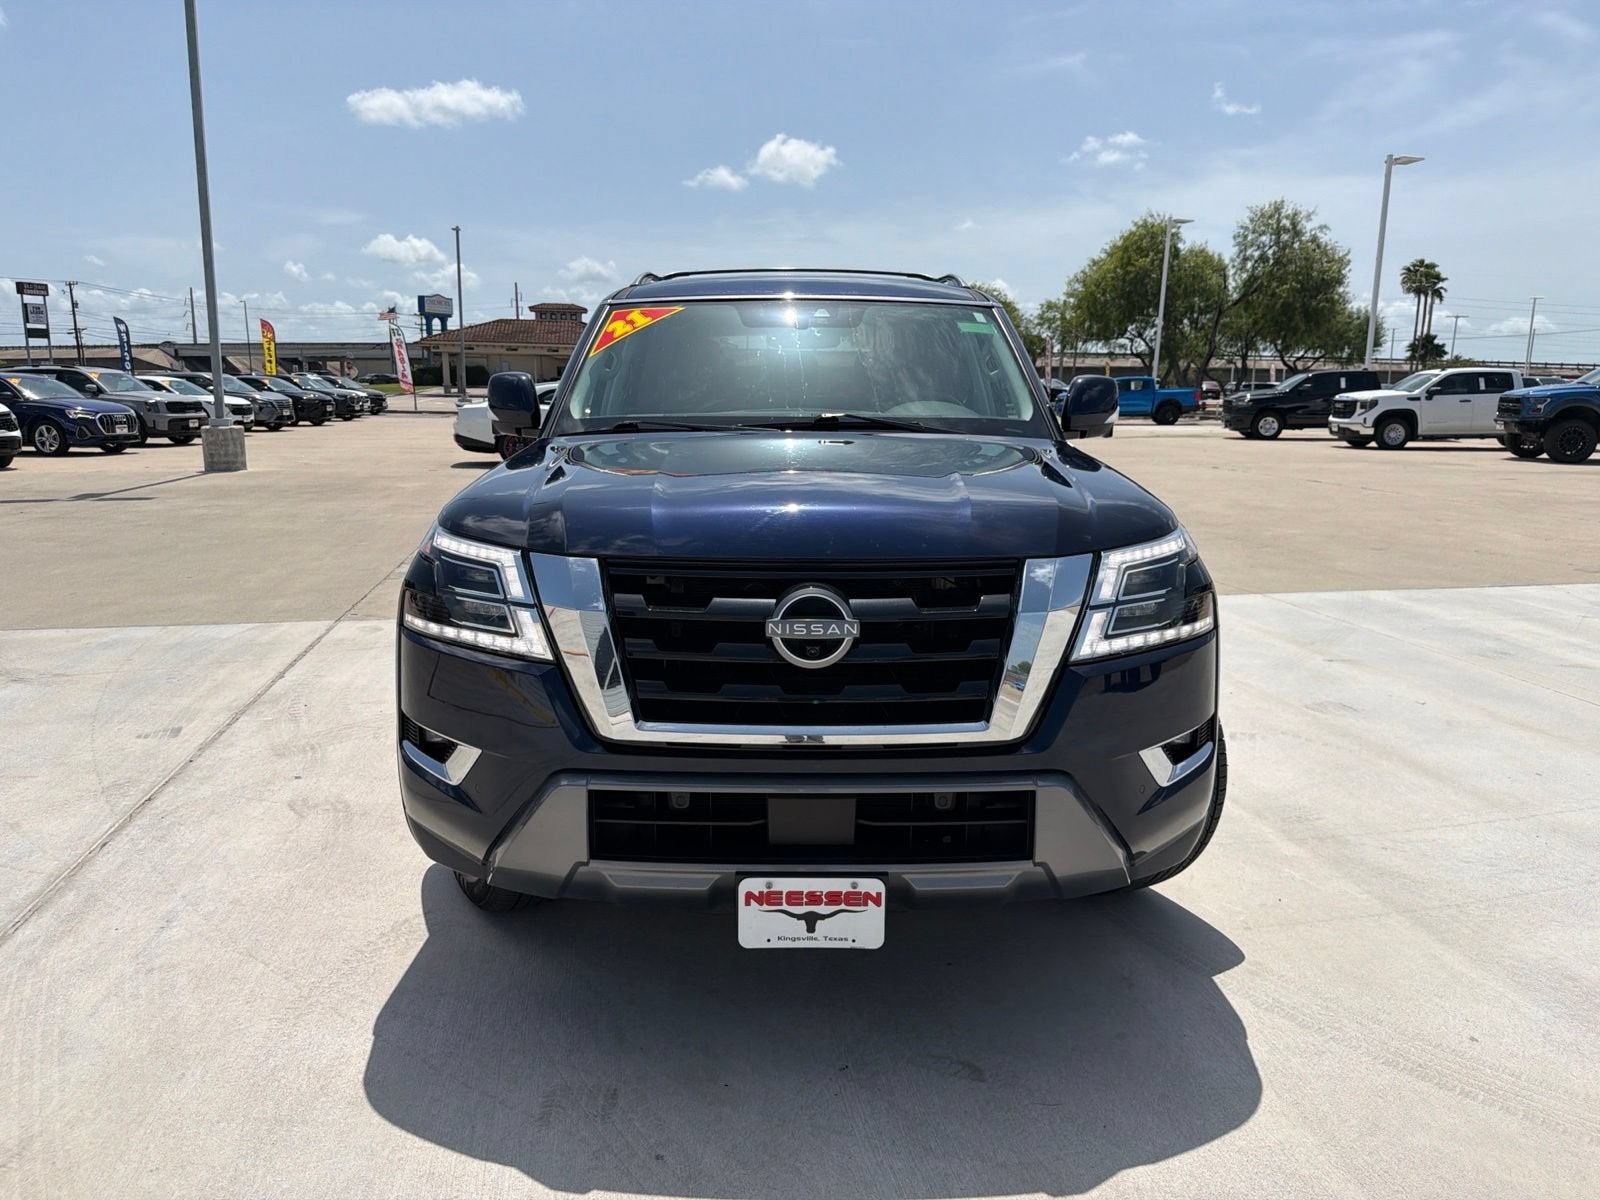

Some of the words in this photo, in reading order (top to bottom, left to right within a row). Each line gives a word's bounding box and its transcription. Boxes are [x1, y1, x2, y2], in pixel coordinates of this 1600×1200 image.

[606, 310, 652, 338] 21
[768, 623, 858, 635] NISSAN
[744, 890, 882, 907] NEESSEN
